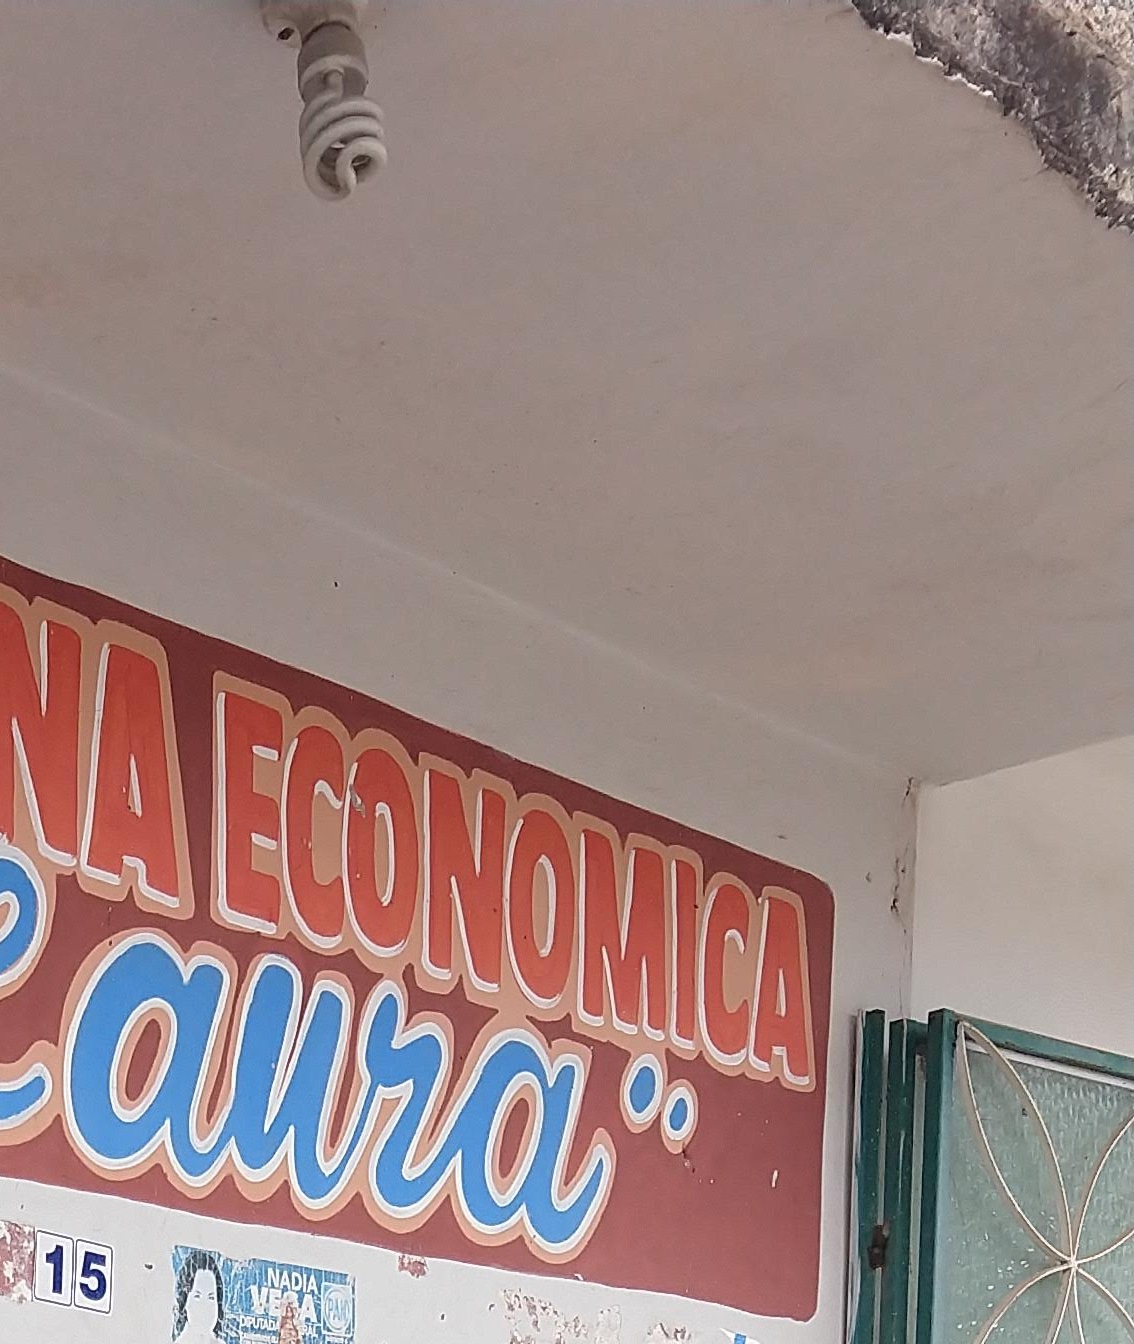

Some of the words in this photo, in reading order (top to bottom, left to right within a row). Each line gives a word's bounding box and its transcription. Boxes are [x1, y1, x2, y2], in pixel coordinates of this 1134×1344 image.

[208, 686, 818, 1092] ECONOMICA
[44, 1245, 107, 1300] 15
[267, 1267, 318, 1296] NADIA
